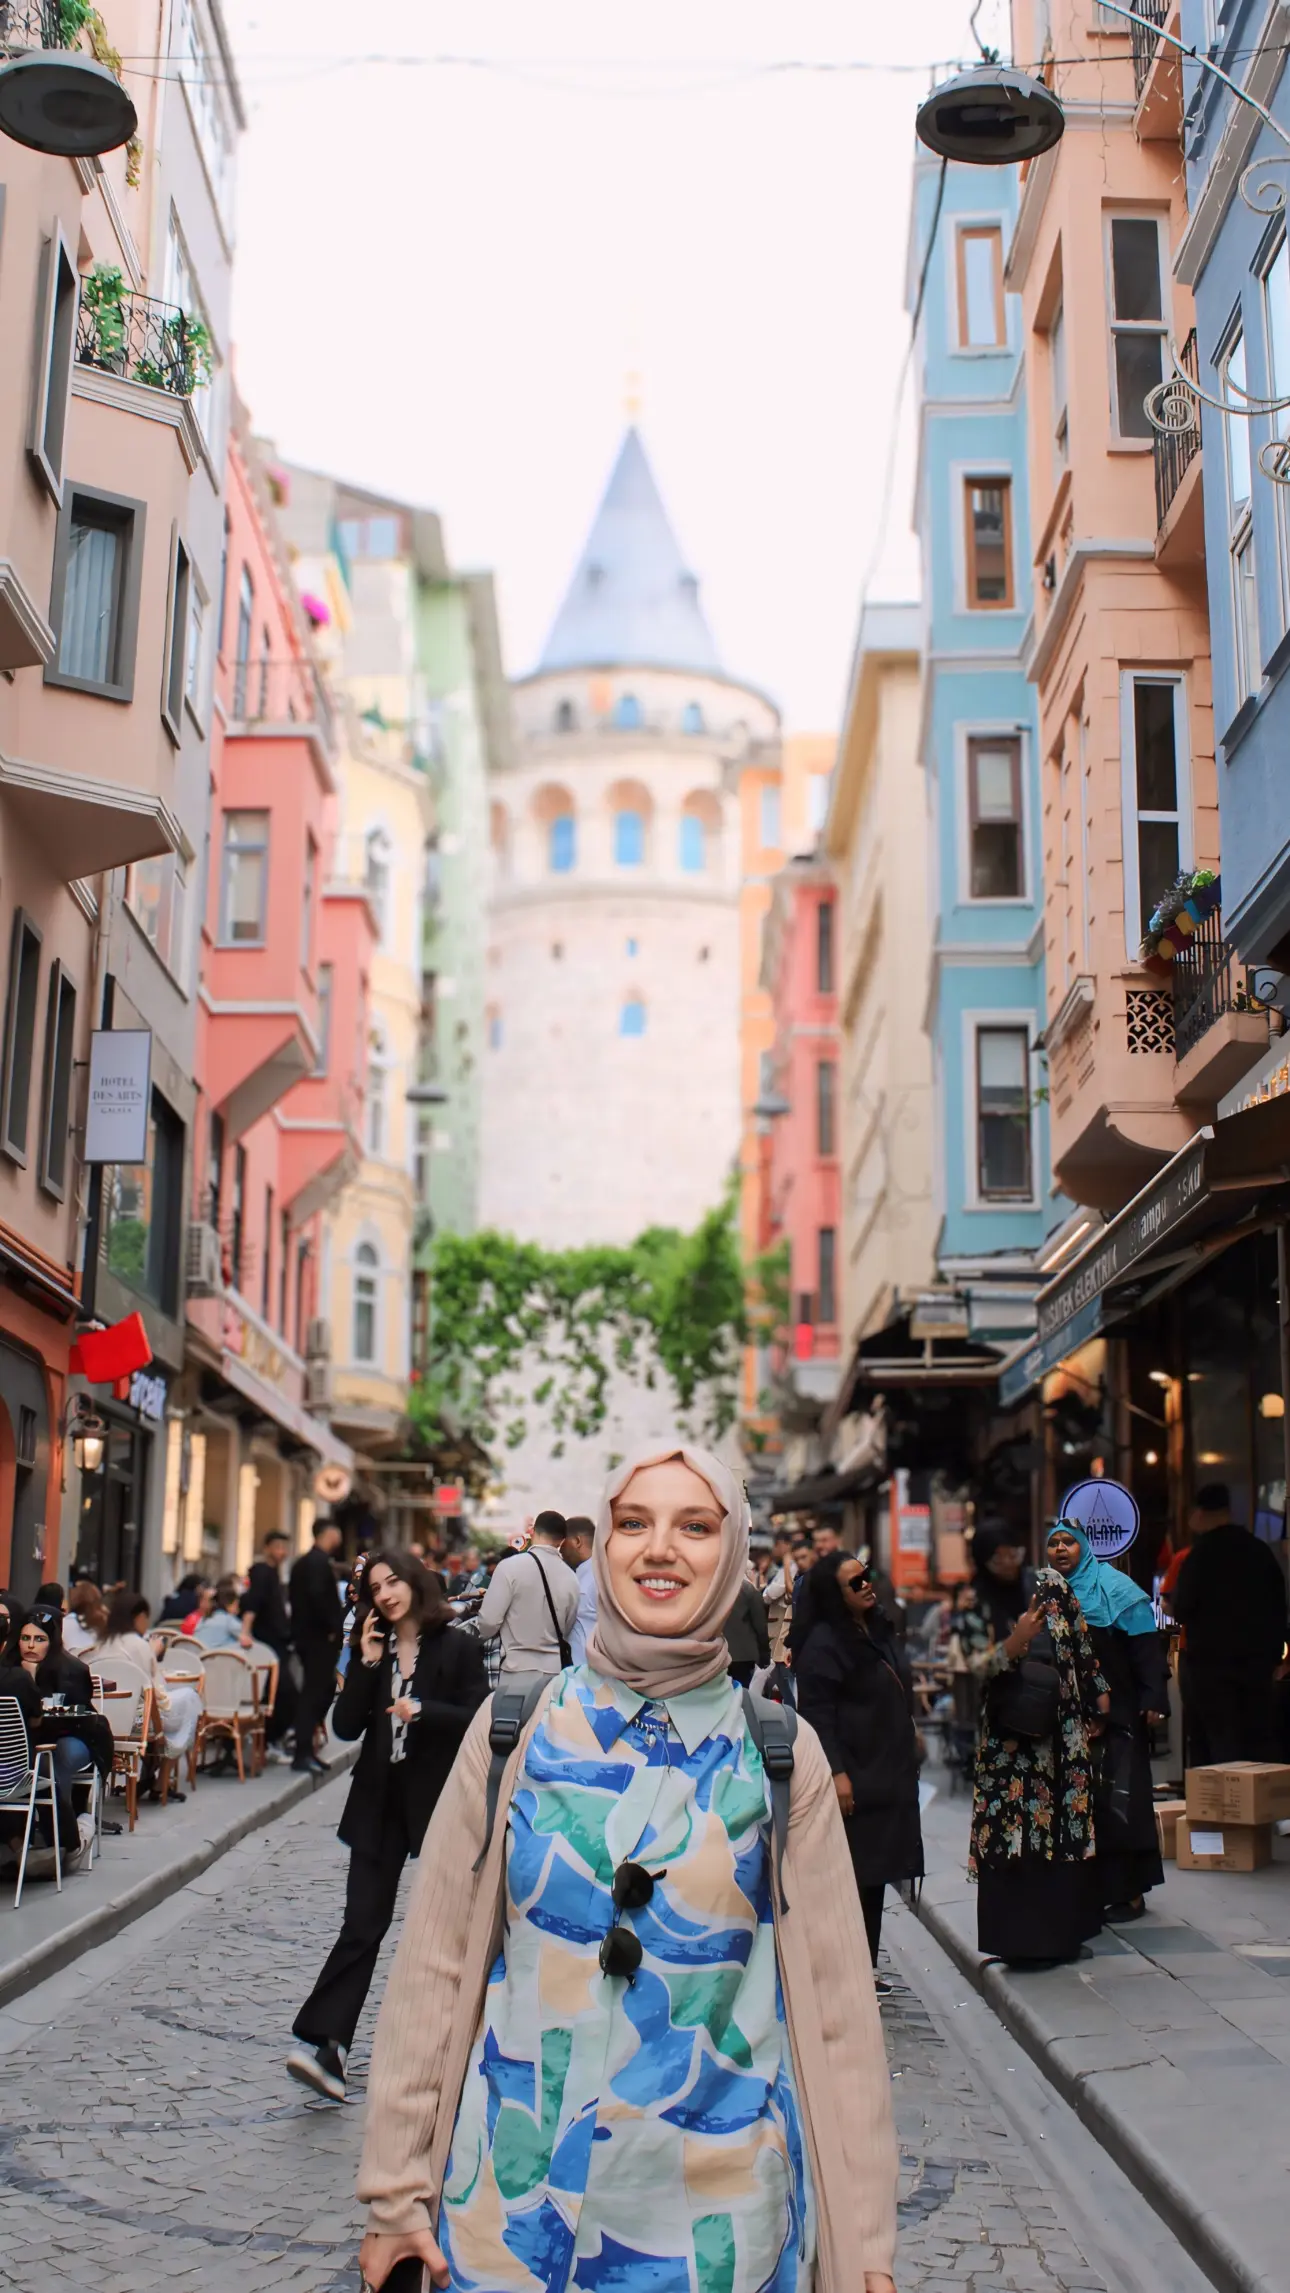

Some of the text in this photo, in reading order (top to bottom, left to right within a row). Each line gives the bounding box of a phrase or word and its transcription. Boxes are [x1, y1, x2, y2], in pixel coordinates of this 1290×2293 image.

[101, 1077, 136, 1087] HOTEL
[93, 1091, 143, 1101] DES ARTS
[1086, 1524, 1130, 1541] ALATA
